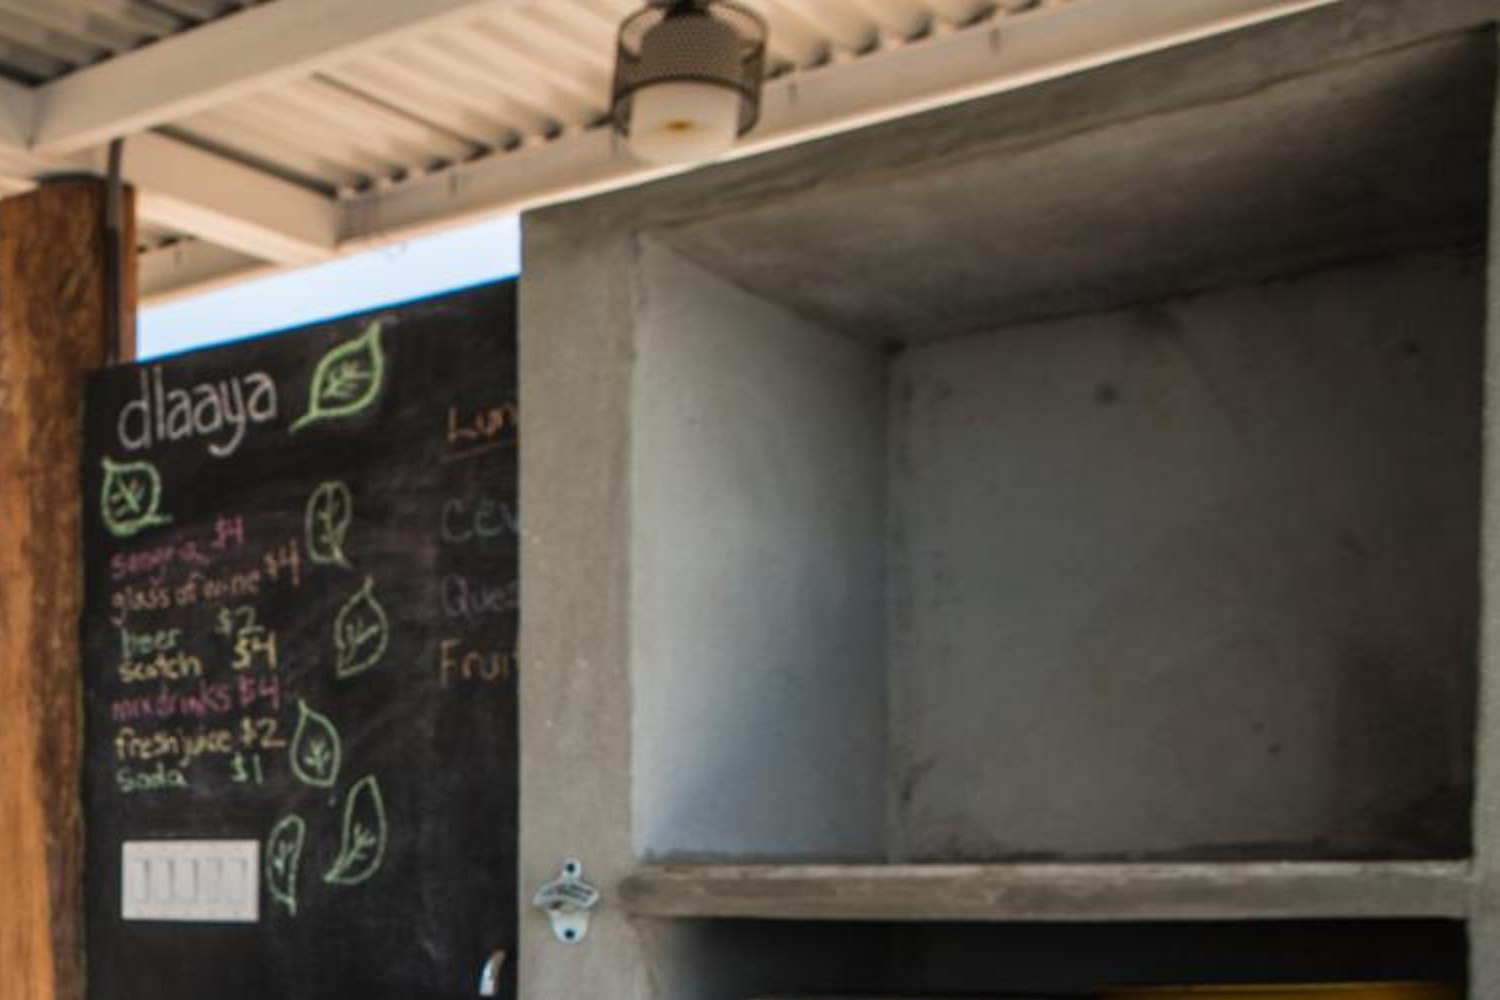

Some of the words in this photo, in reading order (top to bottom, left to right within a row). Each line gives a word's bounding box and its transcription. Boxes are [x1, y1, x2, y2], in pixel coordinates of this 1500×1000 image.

[117, 365, 278, 458] dlaaya
[214, 604, 266, 637] $2
[231, 629, 277, 671] $4
[240, 714, 287, 750] $2
